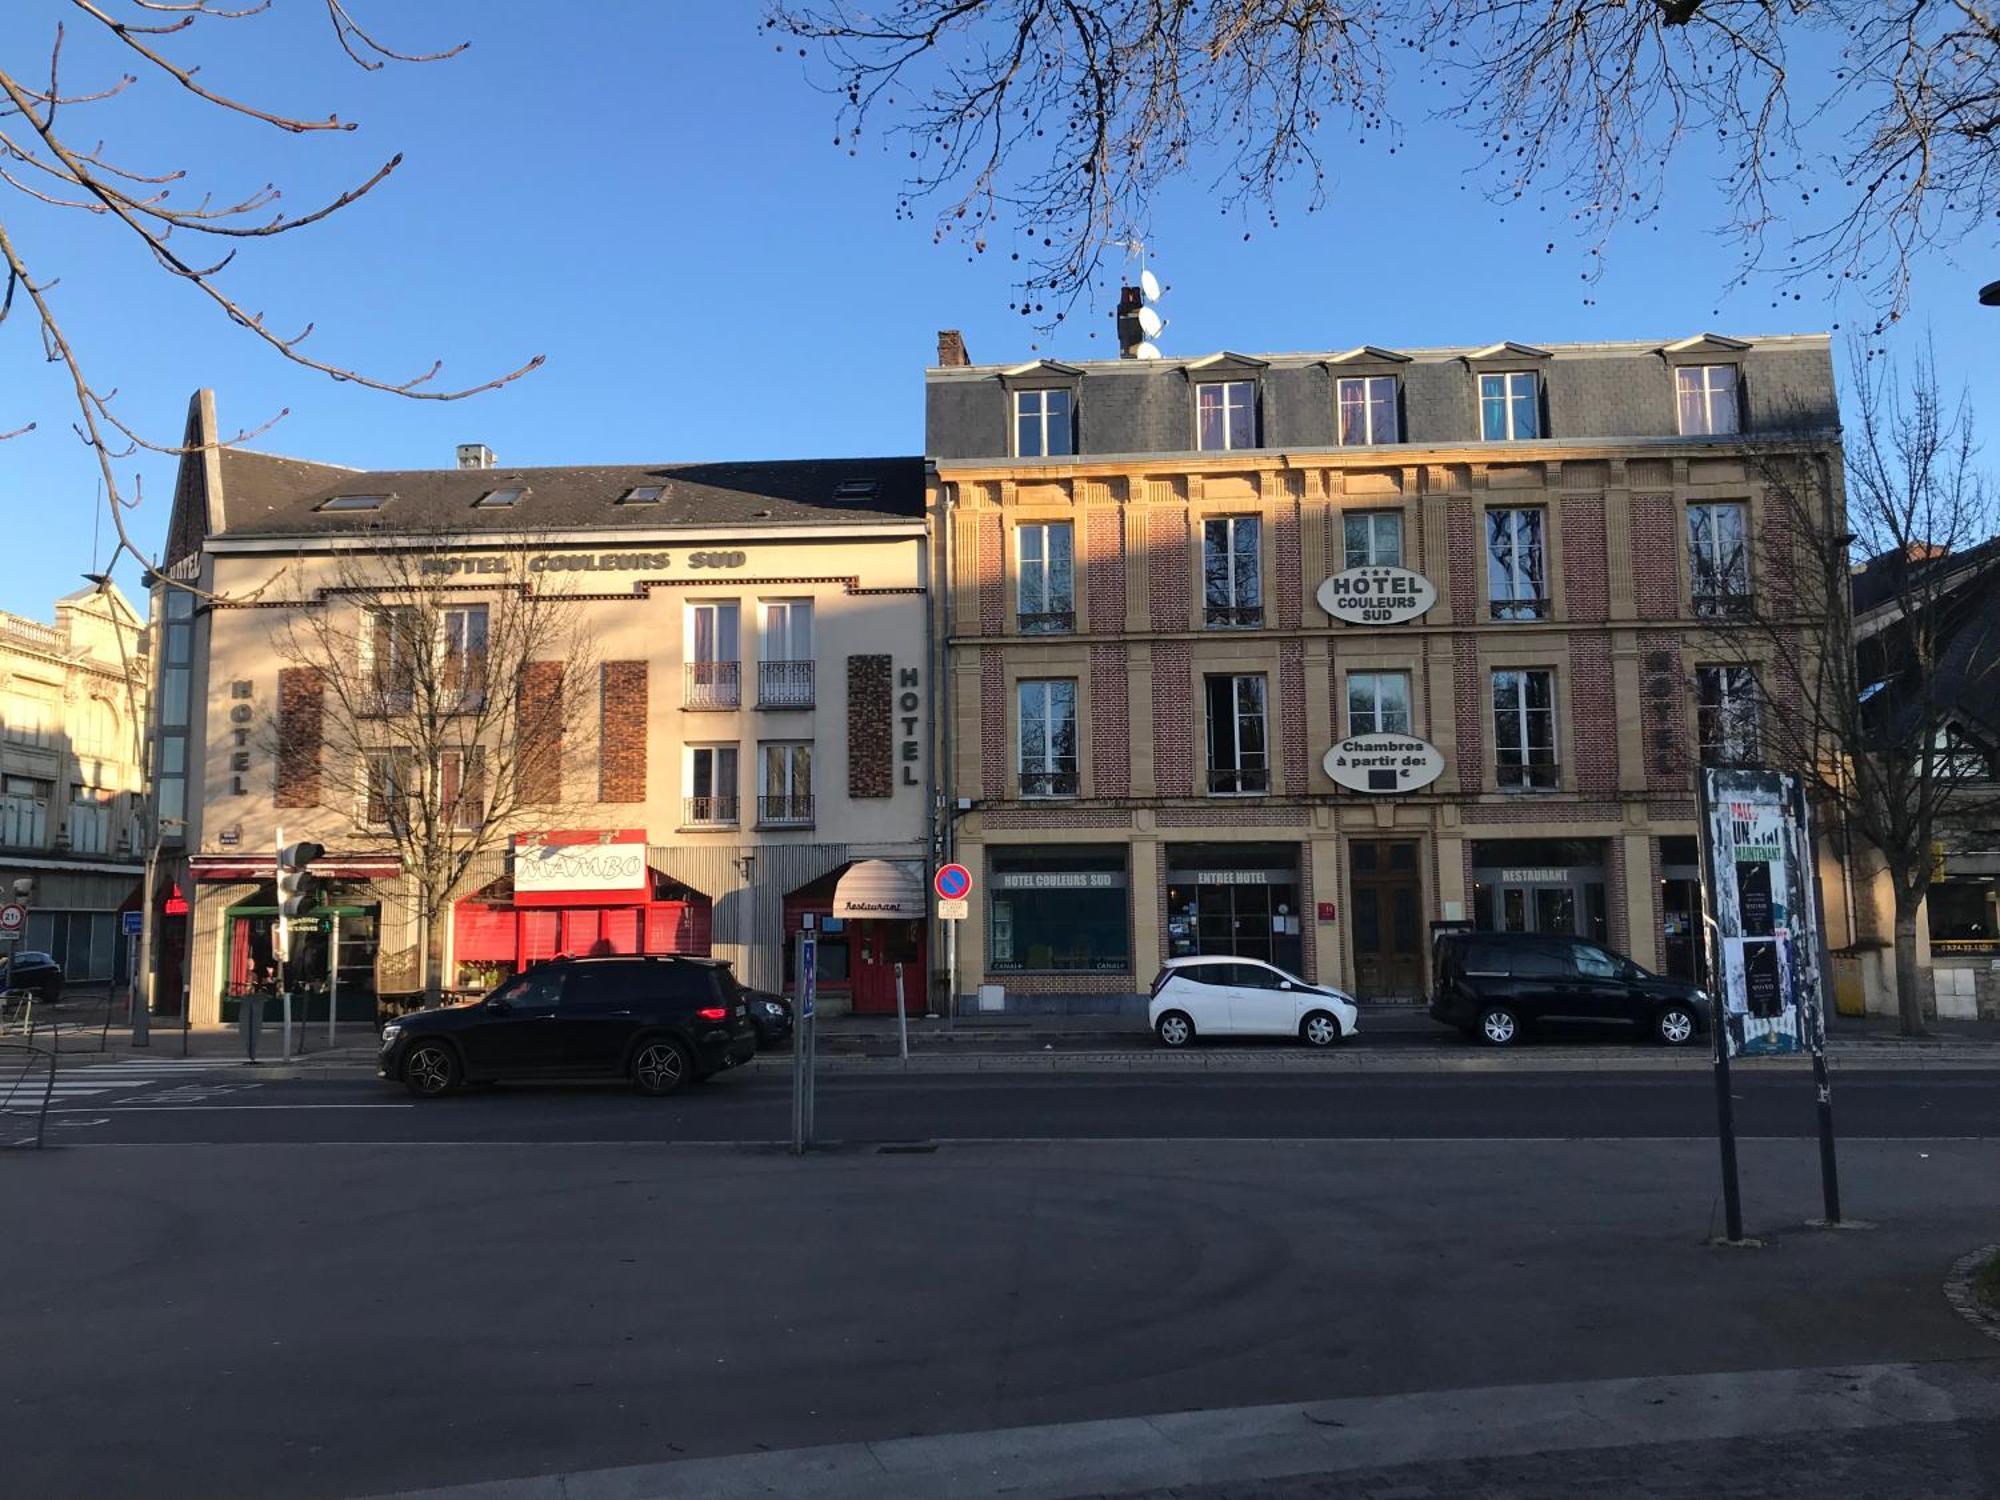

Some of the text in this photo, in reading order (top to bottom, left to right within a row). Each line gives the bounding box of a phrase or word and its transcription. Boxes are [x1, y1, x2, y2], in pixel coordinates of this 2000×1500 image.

[422, 551, 746, 575] HOTEL COULEURS SUD
[1333, 577, 1423, 595] HOTEL
[1337, 596, 1416, 609] COULEURS
[1362, 609, 1392, 621] SUD
[899, 667, 919, 786] HOTEL
[229, 679, 253, 796] HOTEL
[1342, 742, 1424, 752] Chambres
[1336, 755, 1427, 769] à partir de:
[1400, 769, 1411, 777] €
[1733, 821, 1750, 844] UN
[1004, 873, 1112, 887] HOTEL COULEURS SUD
[1198, 872, 1268, 884] ENTREE HOTEL
[1502, 870, 1568, 882] RESTAURANT
[844, 901, 902, 911] Restaurant
